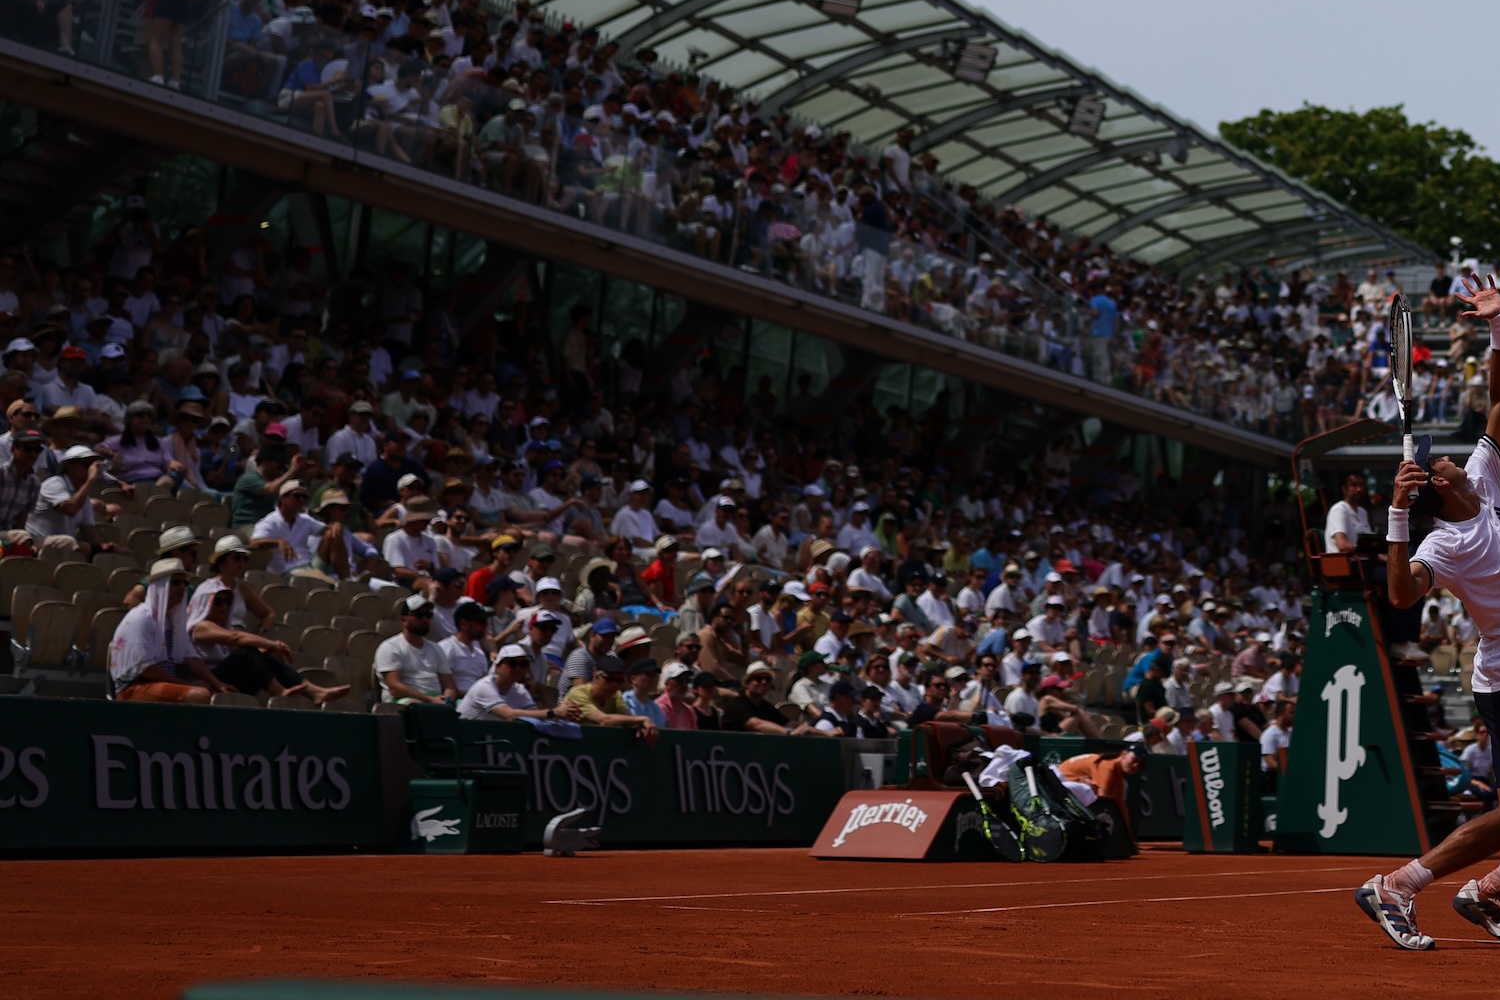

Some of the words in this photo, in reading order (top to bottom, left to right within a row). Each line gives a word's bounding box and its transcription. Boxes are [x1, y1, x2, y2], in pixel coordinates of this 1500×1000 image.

[1325, 607, 1363, 638] perrier
[89, 734, 352, 811] Emirates
[673, 743, 796, 827] Infosys
[1199, 746, 1226, 830] Wilson
[475, 813, 520, 829] LACOSTE
[831, 799, 928, 849] perrier
